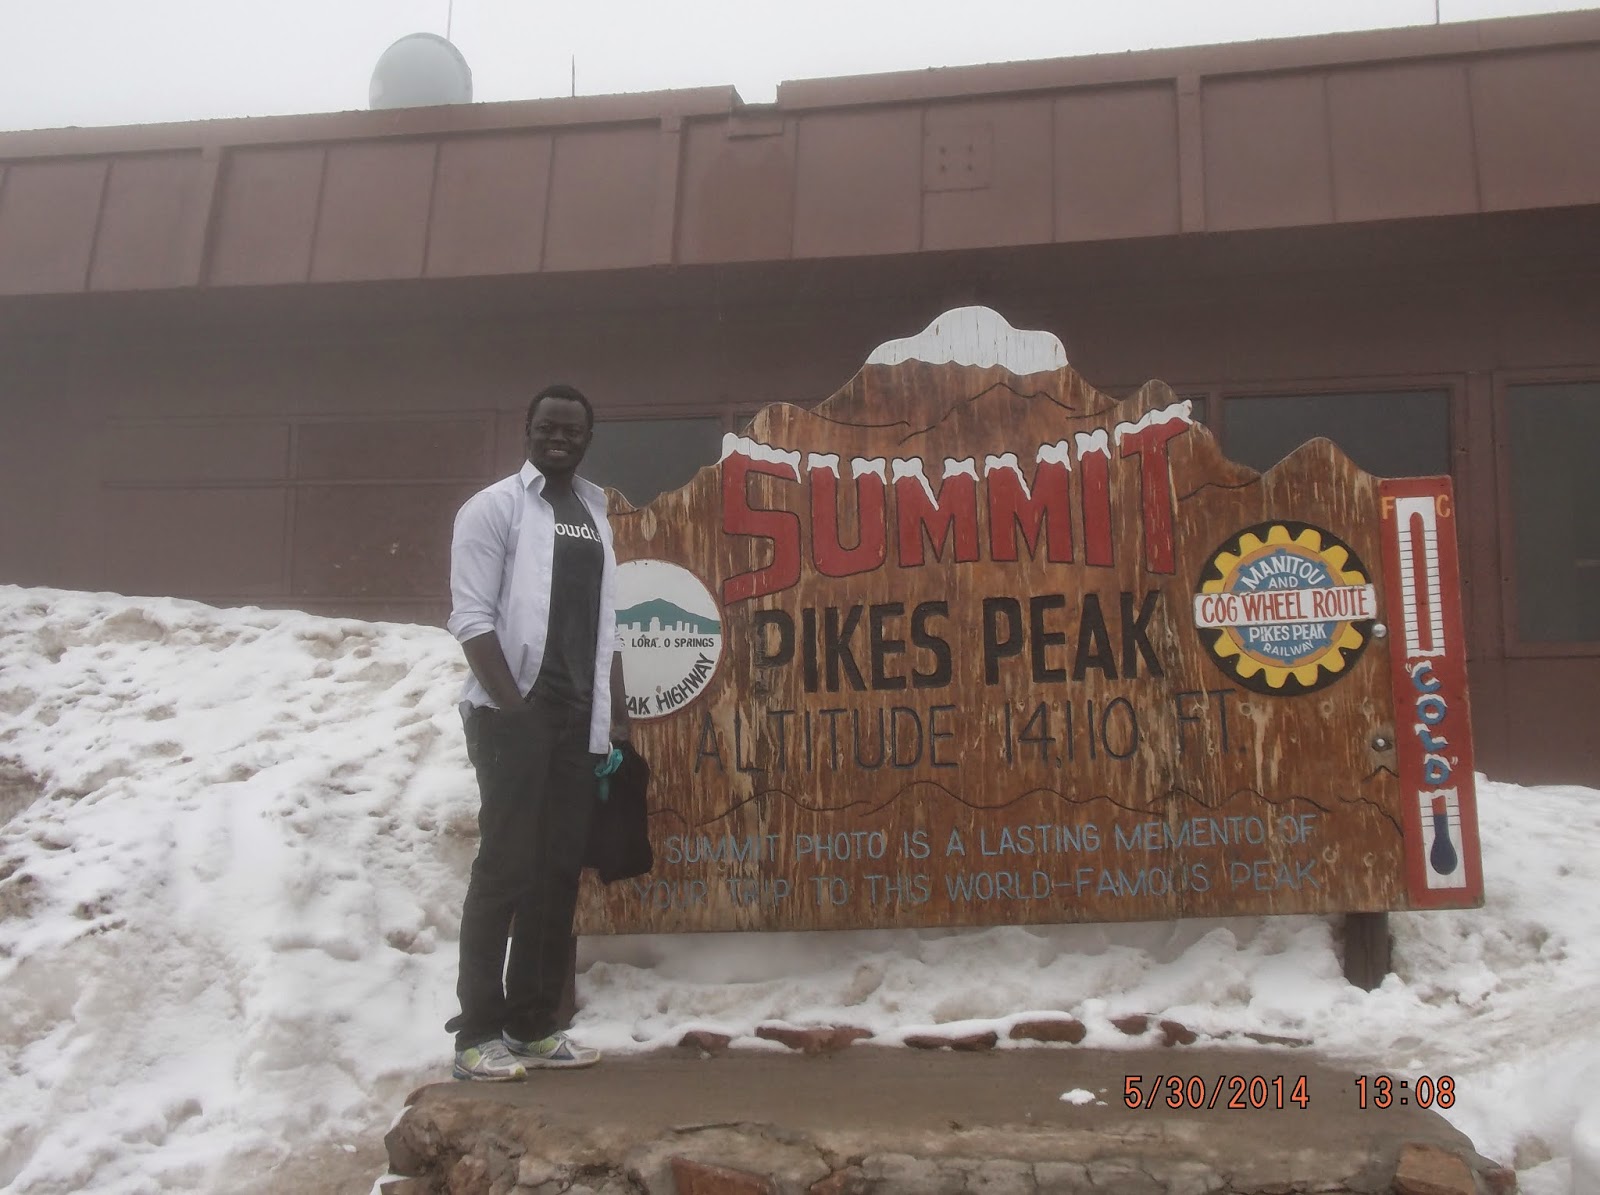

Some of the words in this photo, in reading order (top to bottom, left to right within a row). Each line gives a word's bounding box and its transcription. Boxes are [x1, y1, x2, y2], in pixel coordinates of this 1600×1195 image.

[720, 400, 1193, 606] SUMMIT
[1381, 496, 1395, 519] F
[1436, 494, 1451, 518] C
[1241, 555, 1326, 590] MANITOU
[1268, 576, 1299, 589] AND
[1201, 596, 1238, 624] COG
[1241, 592, 1308, 622] WHEEL
[1312, 588, 1370, 618] ROUTE
[674, 637, 714, 648] SPRINGS
[752, 600, 952, 697] PIKES
[982, 589, 1165, 687] PEAK
[1250, 625, 1290, 643] PIKES
[1292, 624, 1327, 641] PEAK
[1263, 640, 1314, 657] RAILWAY
[656, 652, 715, 712] HIGHWAY
[694, 704, 960, 775] ALTITUDE
[666, 833, 780, 864] SUMMIT
[795, 831, 886, 863] PHOTO
[903, 830, 930, 859] IS
[946, 827, 966, 857] A
[980, 823, 1100, 856] LASTING
[1115, 815, 1265, 851] MEMENTO
[1280, 813, 1317, 844] OF
[634, 878, 708, 909] YOUR
[726, 877, 790, 906] TRIP
[810, 877, 850, 905] TO
[864, 874, 931, 905] THIS
[1231, 859, 1321, 892] PEAK
